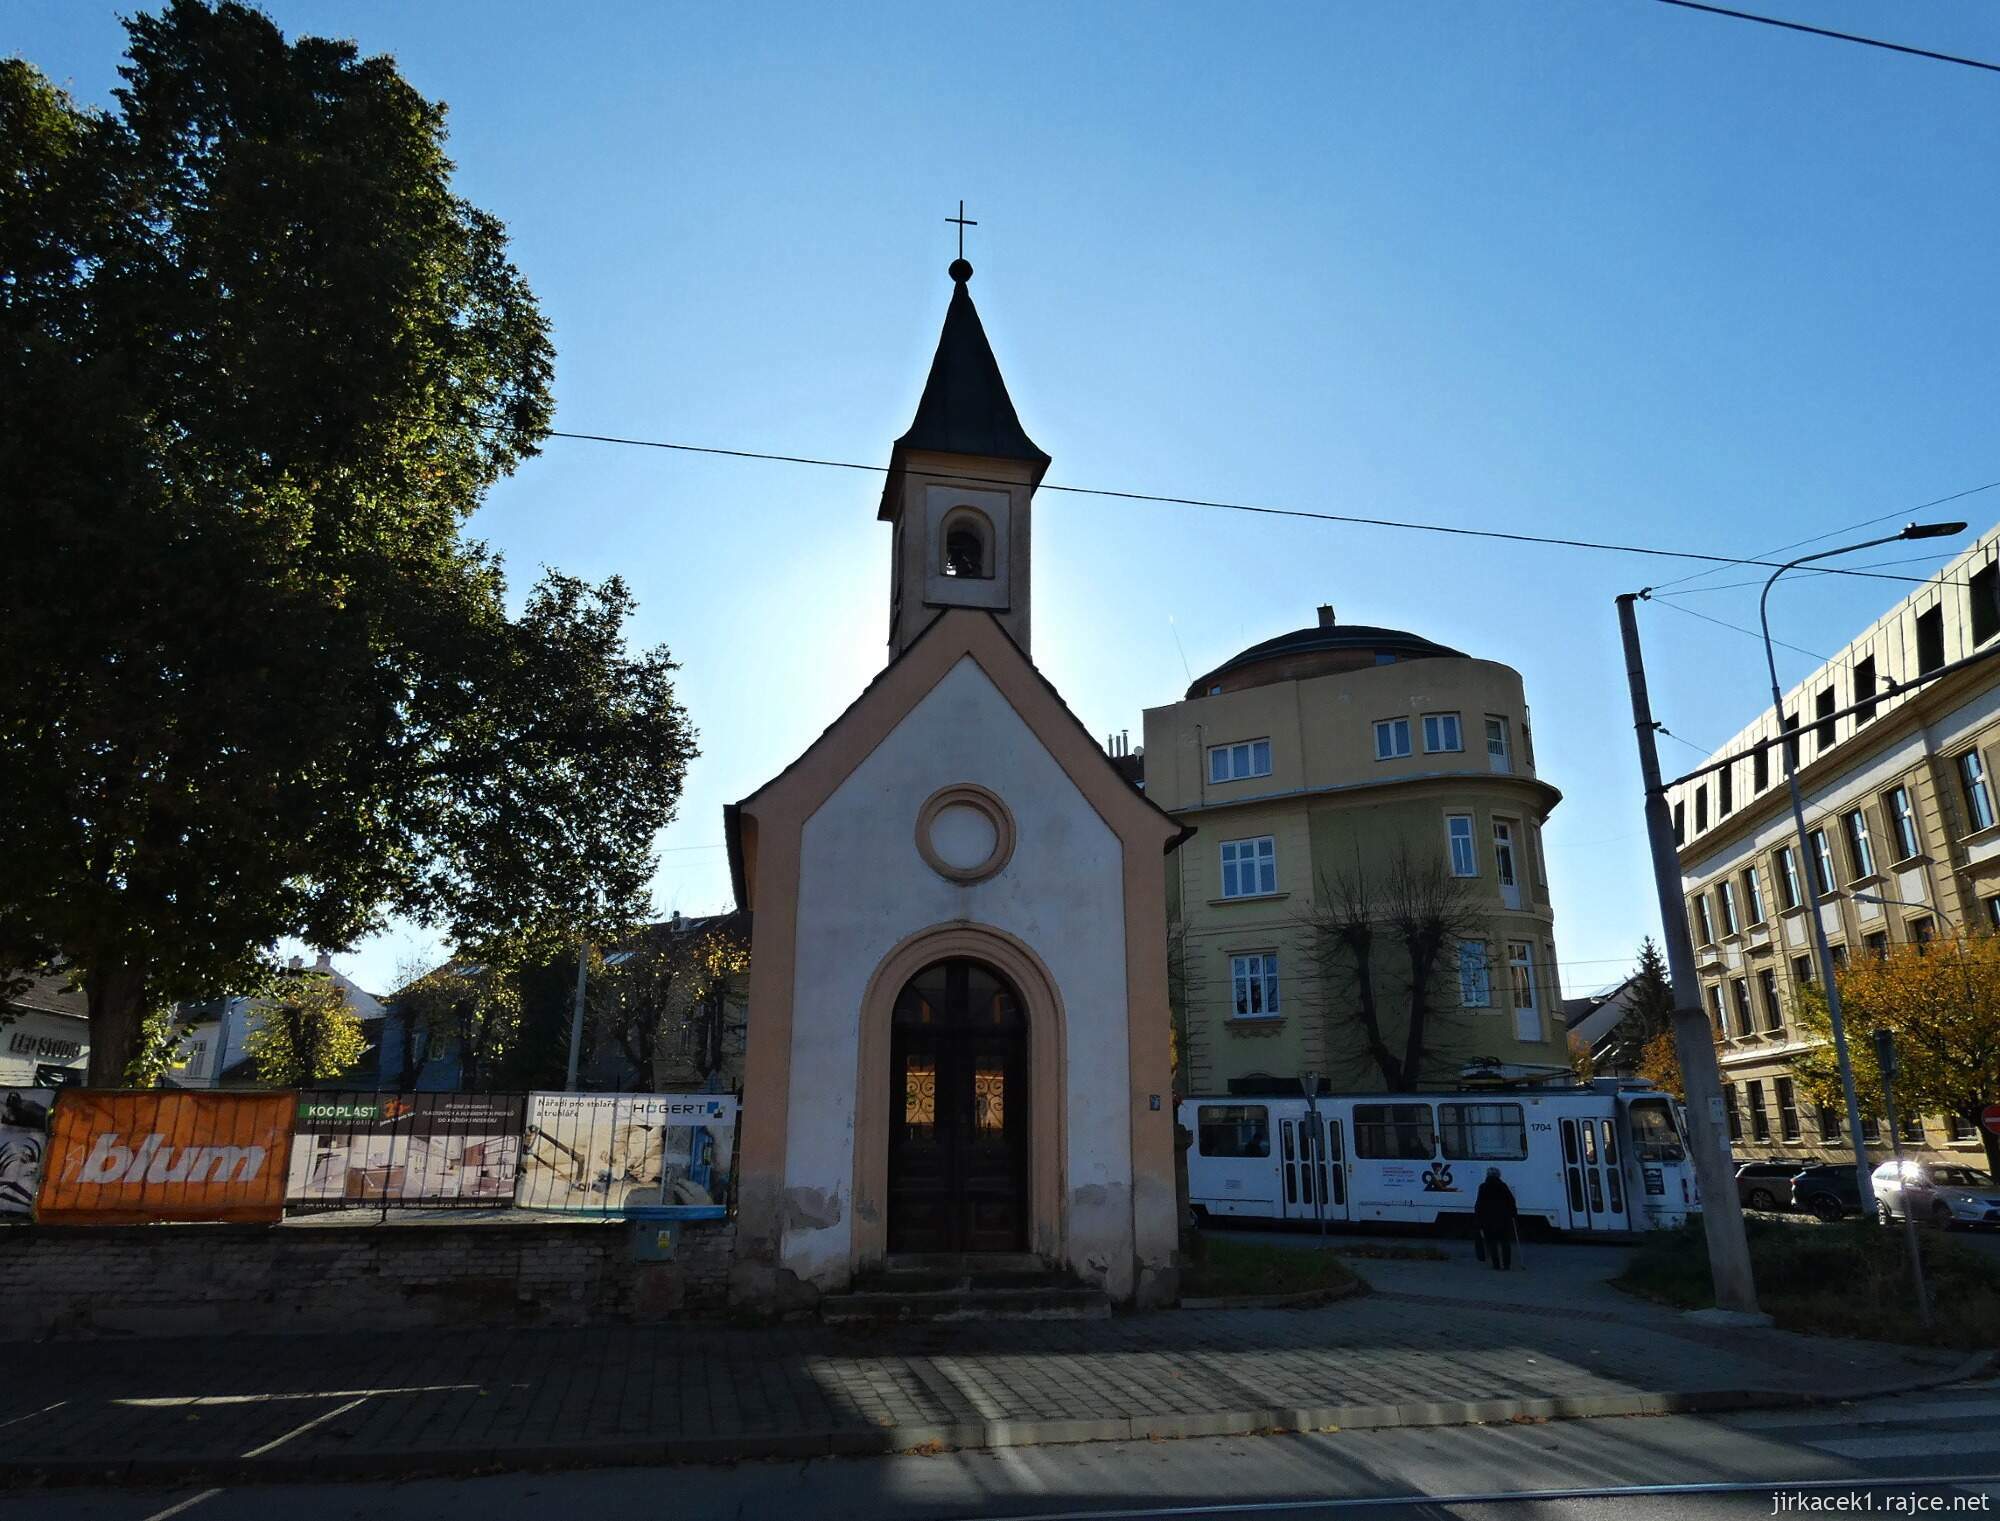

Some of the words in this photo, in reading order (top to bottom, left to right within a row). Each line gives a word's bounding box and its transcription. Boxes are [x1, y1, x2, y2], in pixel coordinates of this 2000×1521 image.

[633, 1101, 706, 1114] HÖGERT
[1530, 1123, 1552, 1131] 1704
[76, 1133, 266, 1184] blum
